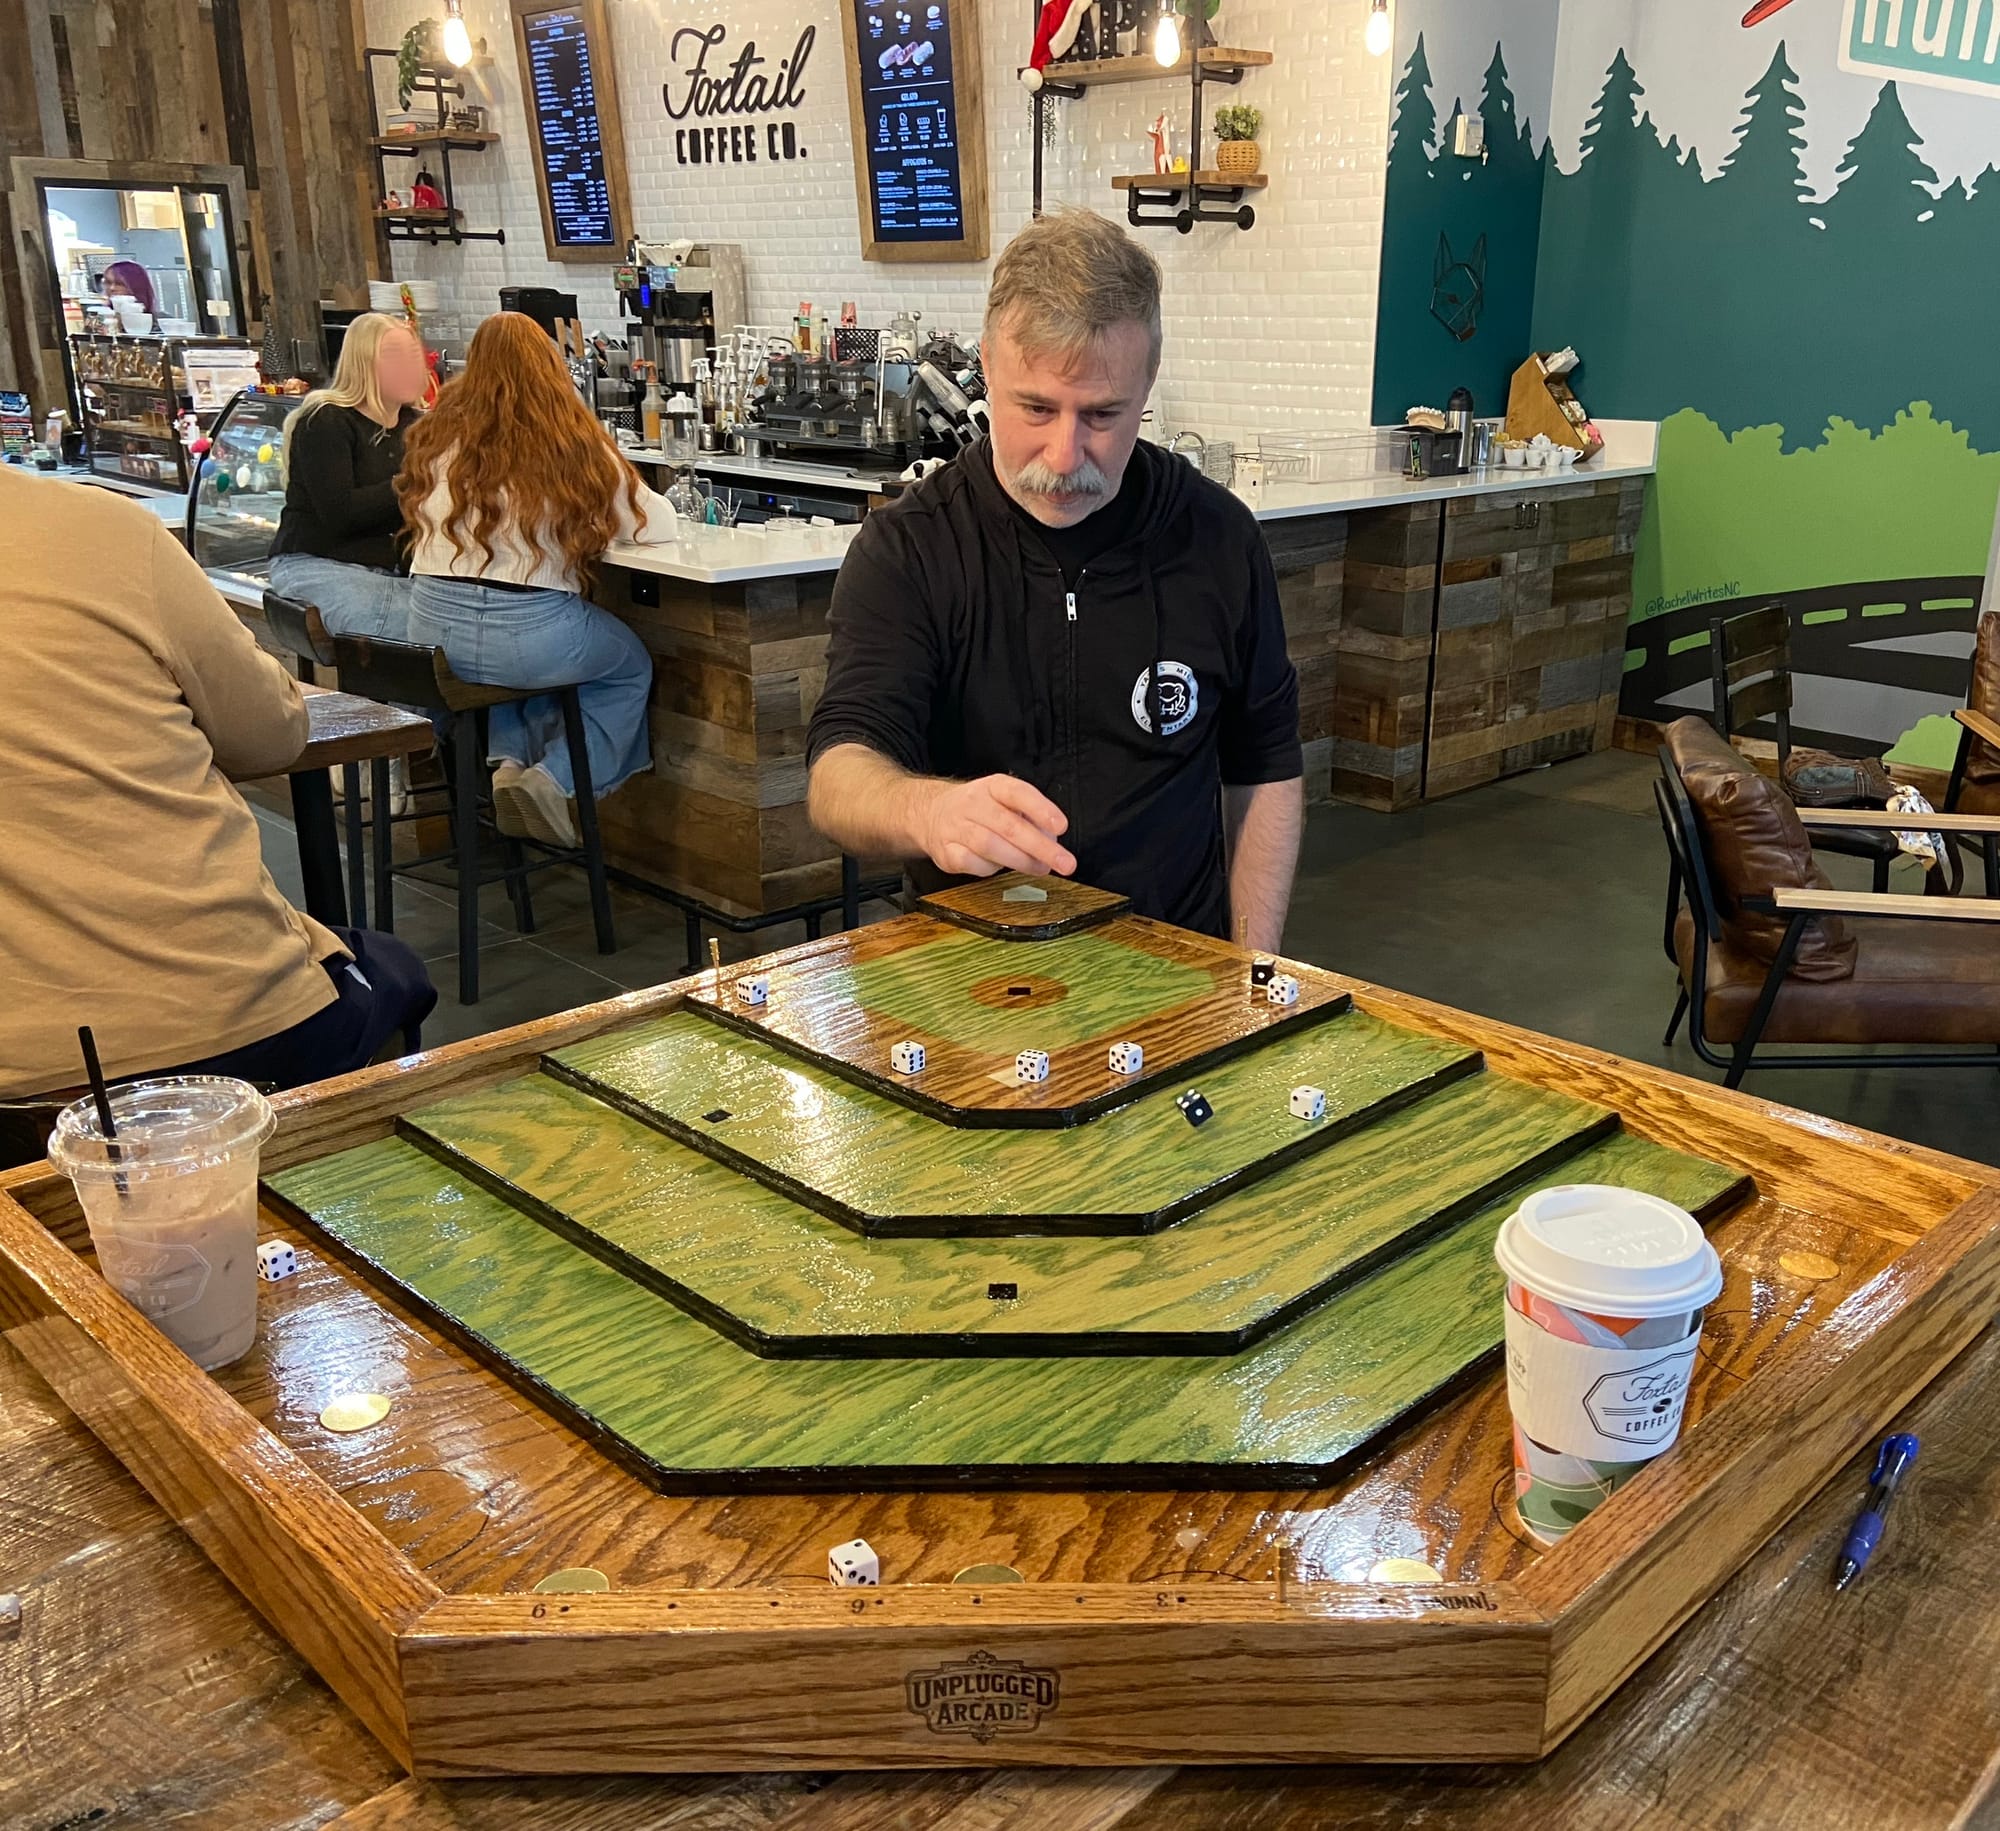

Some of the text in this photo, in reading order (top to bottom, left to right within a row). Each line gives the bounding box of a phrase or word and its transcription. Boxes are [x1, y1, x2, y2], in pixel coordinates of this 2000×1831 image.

[662, 23, 816, 120] Foxtail
[674, 121, 808, 165] COFFEE CO.
[1644, 580, 1741, 617] @RachelWritesNC
[1625, 1414, 1669, 1433] COFFEE
[1155, 1591, 1169, 1607] 3
[912, 1673, 1054, 1708] UNPLUGGED
[936, 1701, 1029, 1725] ARCADE
